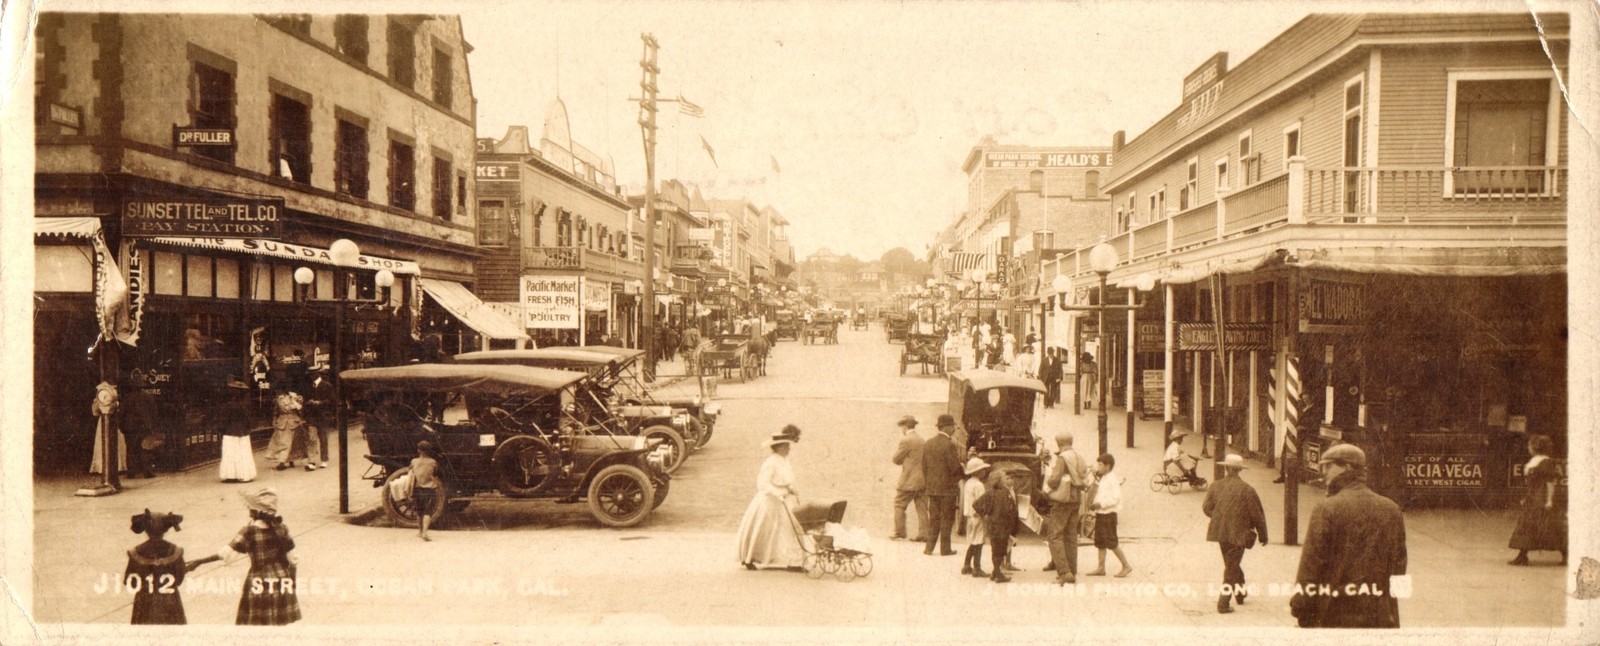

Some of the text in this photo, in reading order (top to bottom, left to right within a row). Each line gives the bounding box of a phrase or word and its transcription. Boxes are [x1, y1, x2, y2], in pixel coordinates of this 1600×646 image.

[194, 132, 230, 142] FULLER
[1047, 153, 1099, 167] HEALD'S
[127, 202, 183, 219] SUNSET
[207, 207, 228, 216] AND
[142, 222, 265, 233] PAY STATION
[243, 239, 330, 261] SUNDA
[359, 255, 405, 269] SHOP
[526, 280, 551, 293] Pacific
[551, 280, 577, 293] Market
[527, 295, 553, 304] FRESH
[529, 313, 571, 322] POULTRY
[1192, 330, 1215, 343] EAGLE
[149, 368, 171, 384] SUEY
